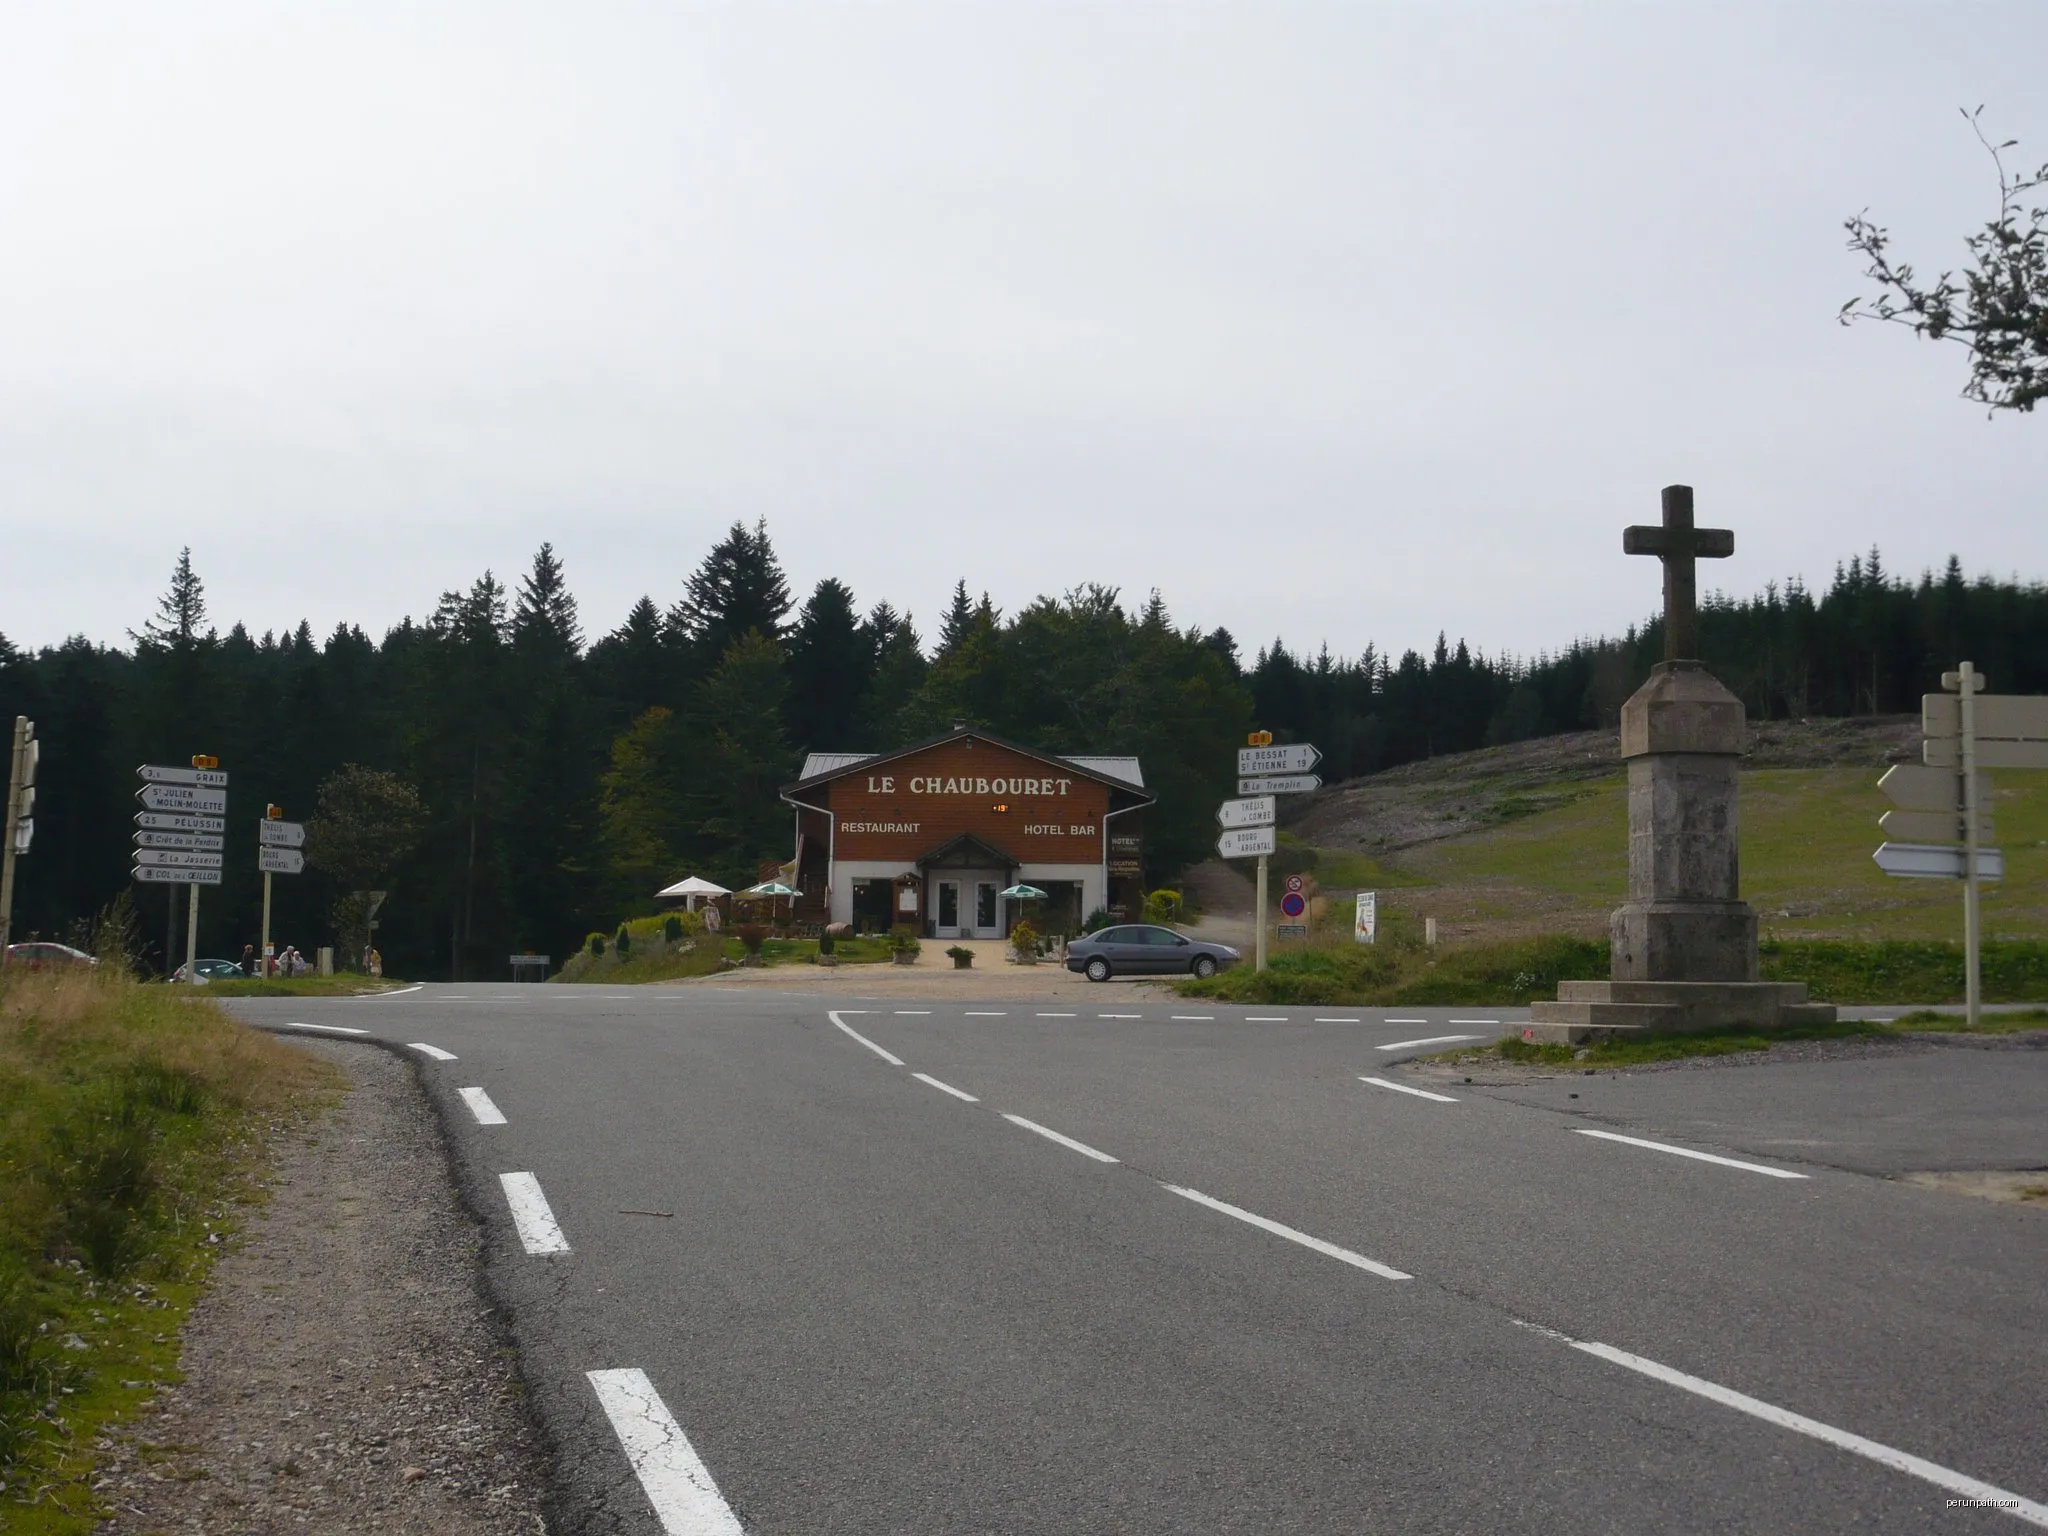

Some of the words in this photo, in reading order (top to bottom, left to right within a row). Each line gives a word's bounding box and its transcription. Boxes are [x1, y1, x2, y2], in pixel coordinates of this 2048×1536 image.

[1241, 752, 1250, 760] LE
[1255, 750, 1287, 759] BESSAT
[1252, 760, 1287, 771] ÉTIENNE
[1297, 760, 1306, 768] 19
[196, 773, 225, 783] GRAIX
[867, 776, 896, 793] LE
[910, 777, 1072, 796] CHAUBOURET
[1267, 780, 1301, 791] Tremplin
[164, 789, 193, 798] JULIEN
[1249, 811, 1271, 821] COMBE
[145, 816, 157, 825] 25
[175, 818, 222, 829] PÉLUSSIN
[841, 822, 920, 834] RESTAURANT
[1024, 824, 1065, 836] HOTEL
[1070, 825, 1095, 836] BAR
[174, 837, 183, 845] de
[185, 837, 193, 845] la
[1237, 832, 1258, 842] BOURG
[1225, 840, 1231, 848] 15
[185, 855, 220, 865] Jasserie
[156, 870, 170, 879] COL
